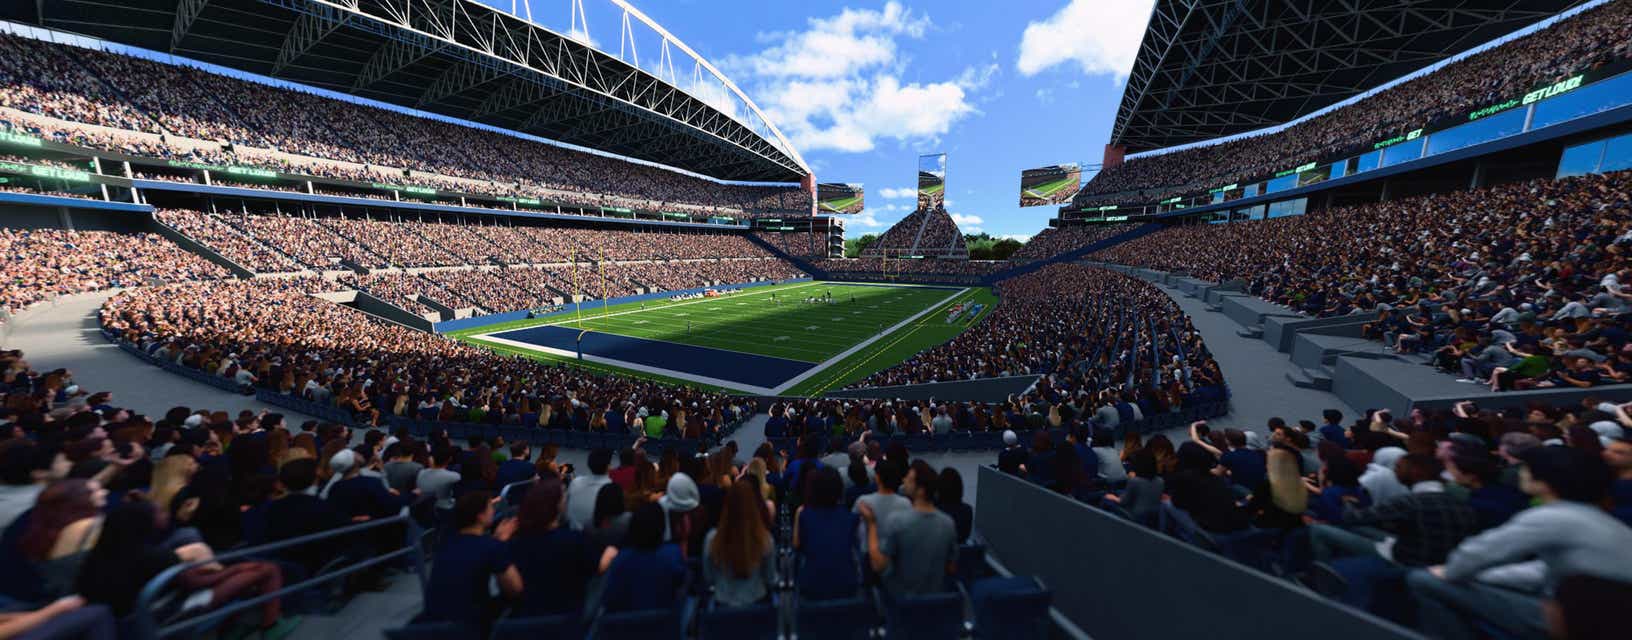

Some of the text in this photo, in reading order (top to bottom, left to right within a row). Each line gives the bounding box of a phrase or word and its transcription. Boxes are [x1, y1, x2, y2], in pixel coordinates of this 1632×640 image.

[1522, 74, 1584, 105] GET LOUD!
[1406, 128, 1423, 141] GET
[32, 165, 56, 177] GET
[228, 166, 248, 175] GET
